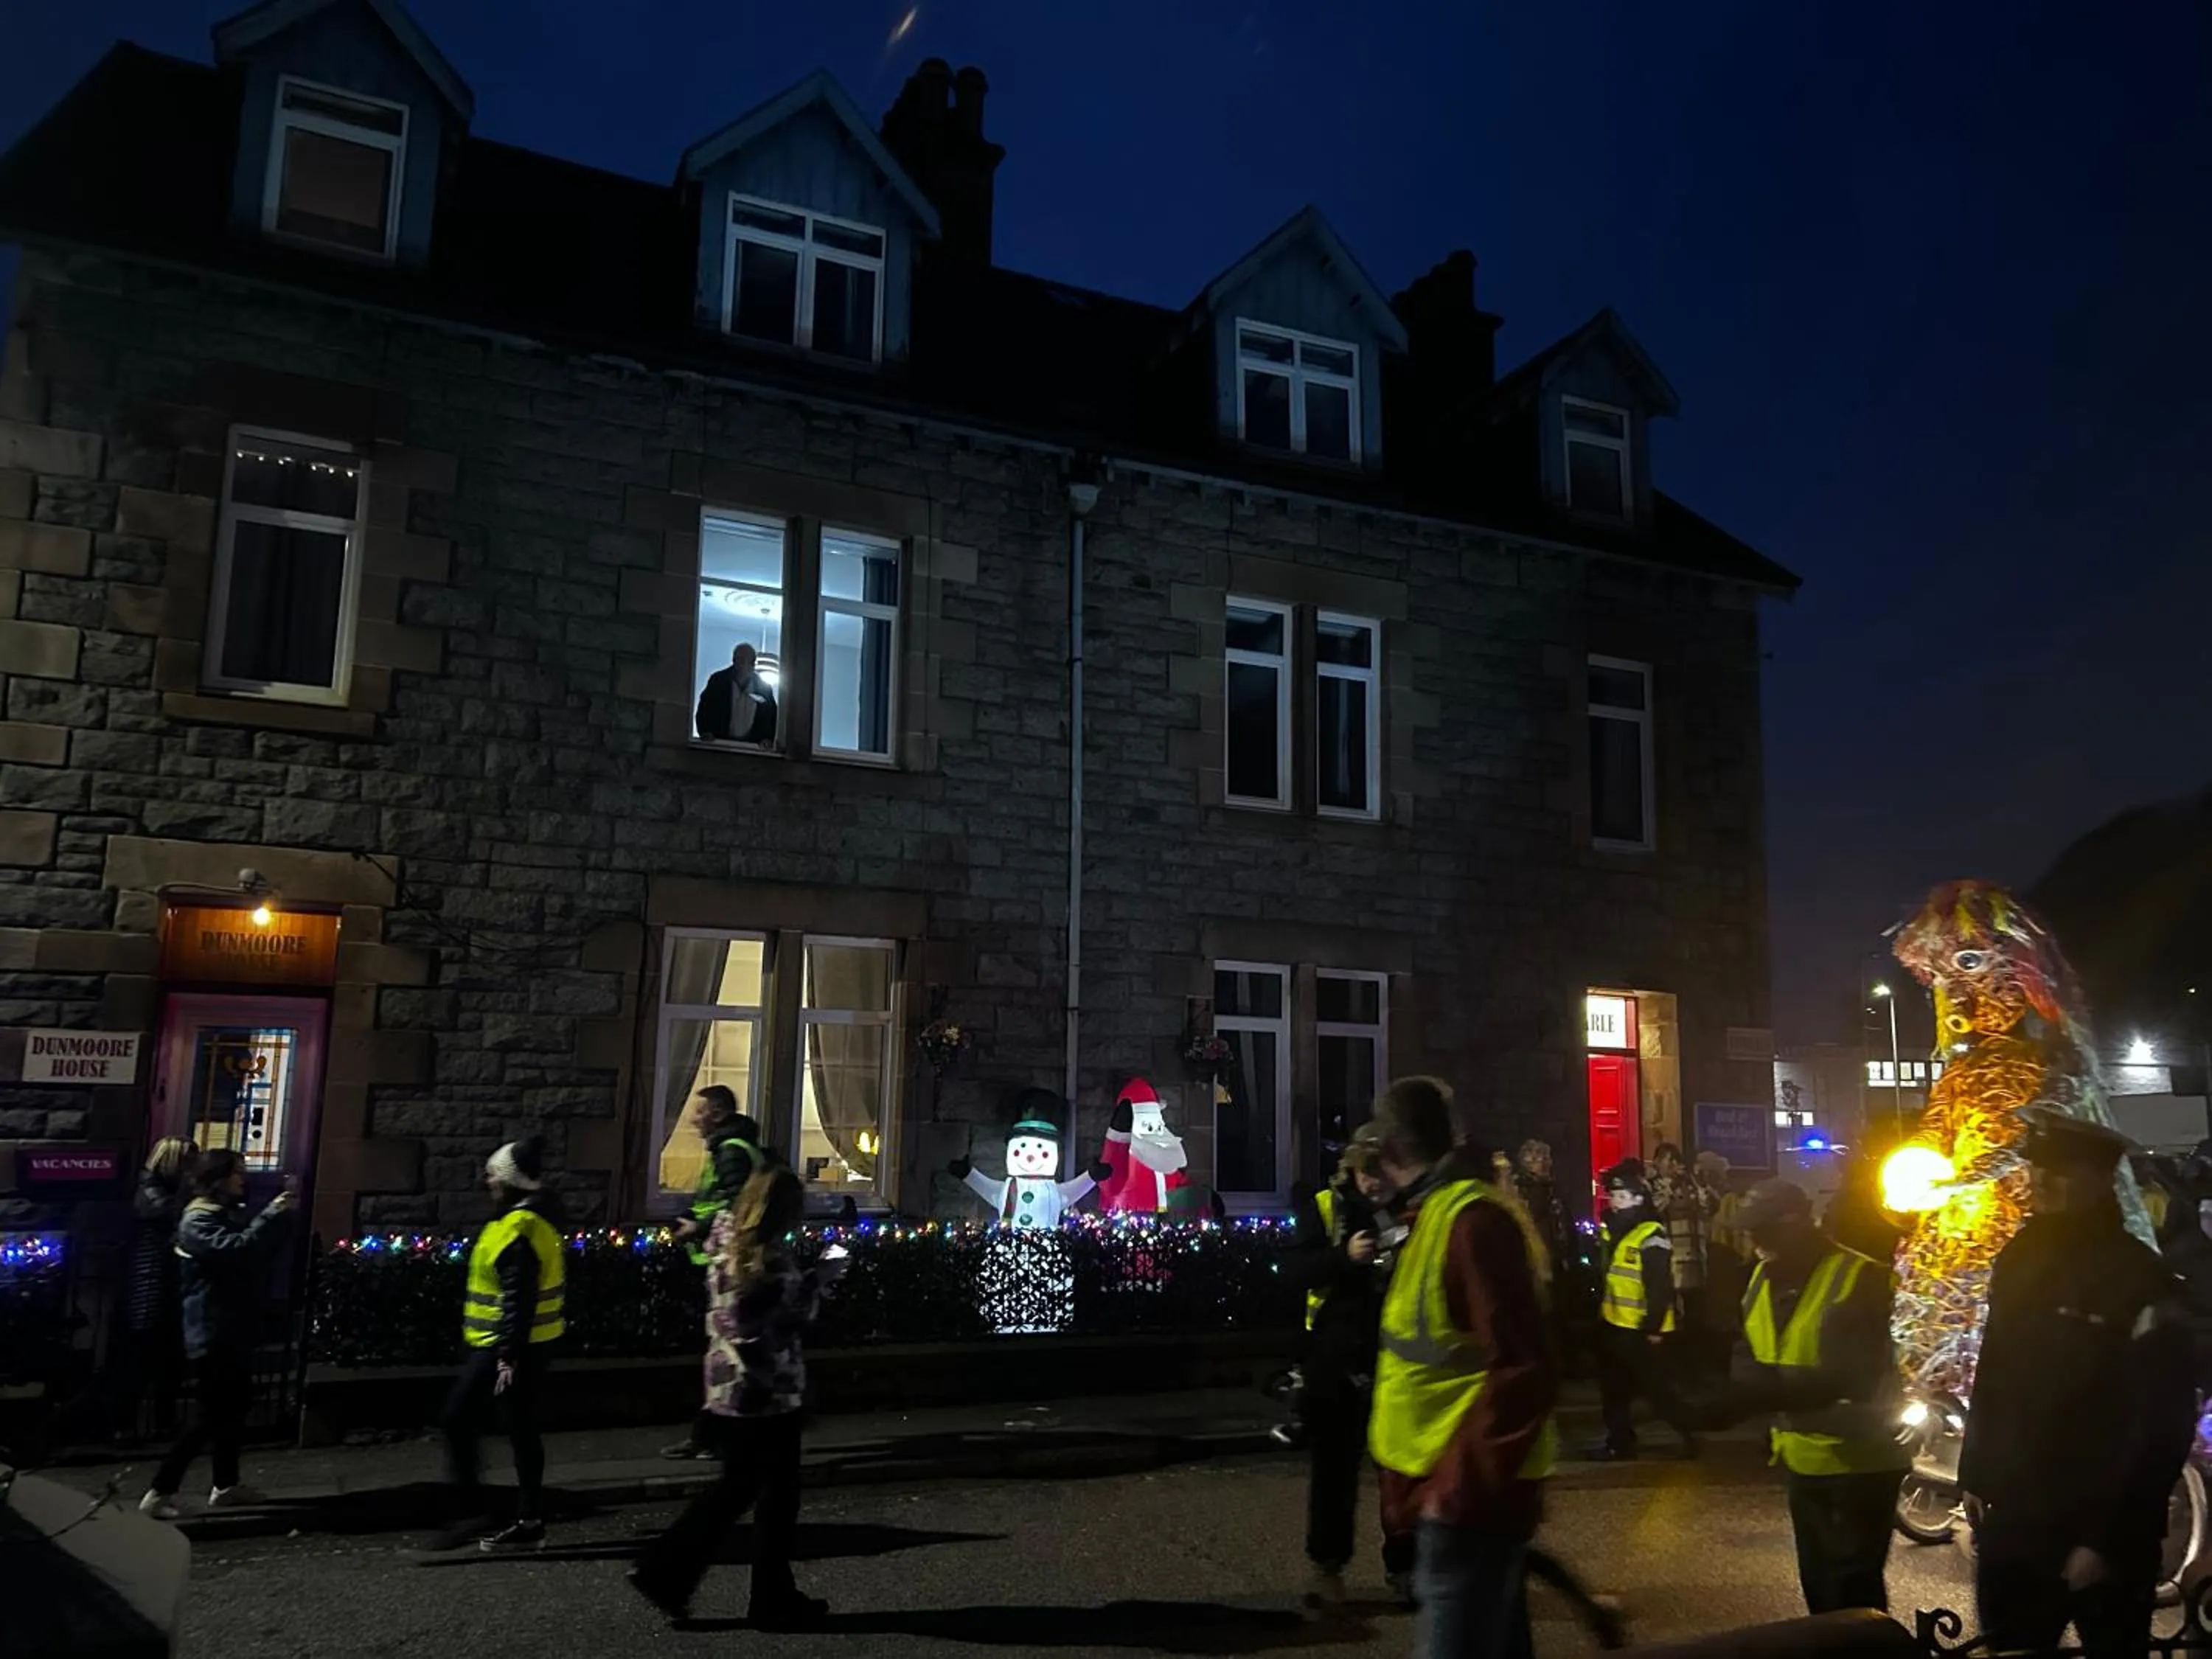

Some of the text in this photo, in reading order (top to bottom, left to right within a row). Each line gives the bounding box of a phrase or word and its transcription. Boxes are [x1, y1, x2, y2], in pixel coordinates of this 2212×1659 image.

[199, 931, 307, 955] DUNMOORE
[1587, 1014, 1615, 1033] RLE
[32, 1036, 136, 1057] DUNMOORE
[49, 1059, 111, 1078] HOUSE
[32, 1158, 112, 1169] VACANCIES
